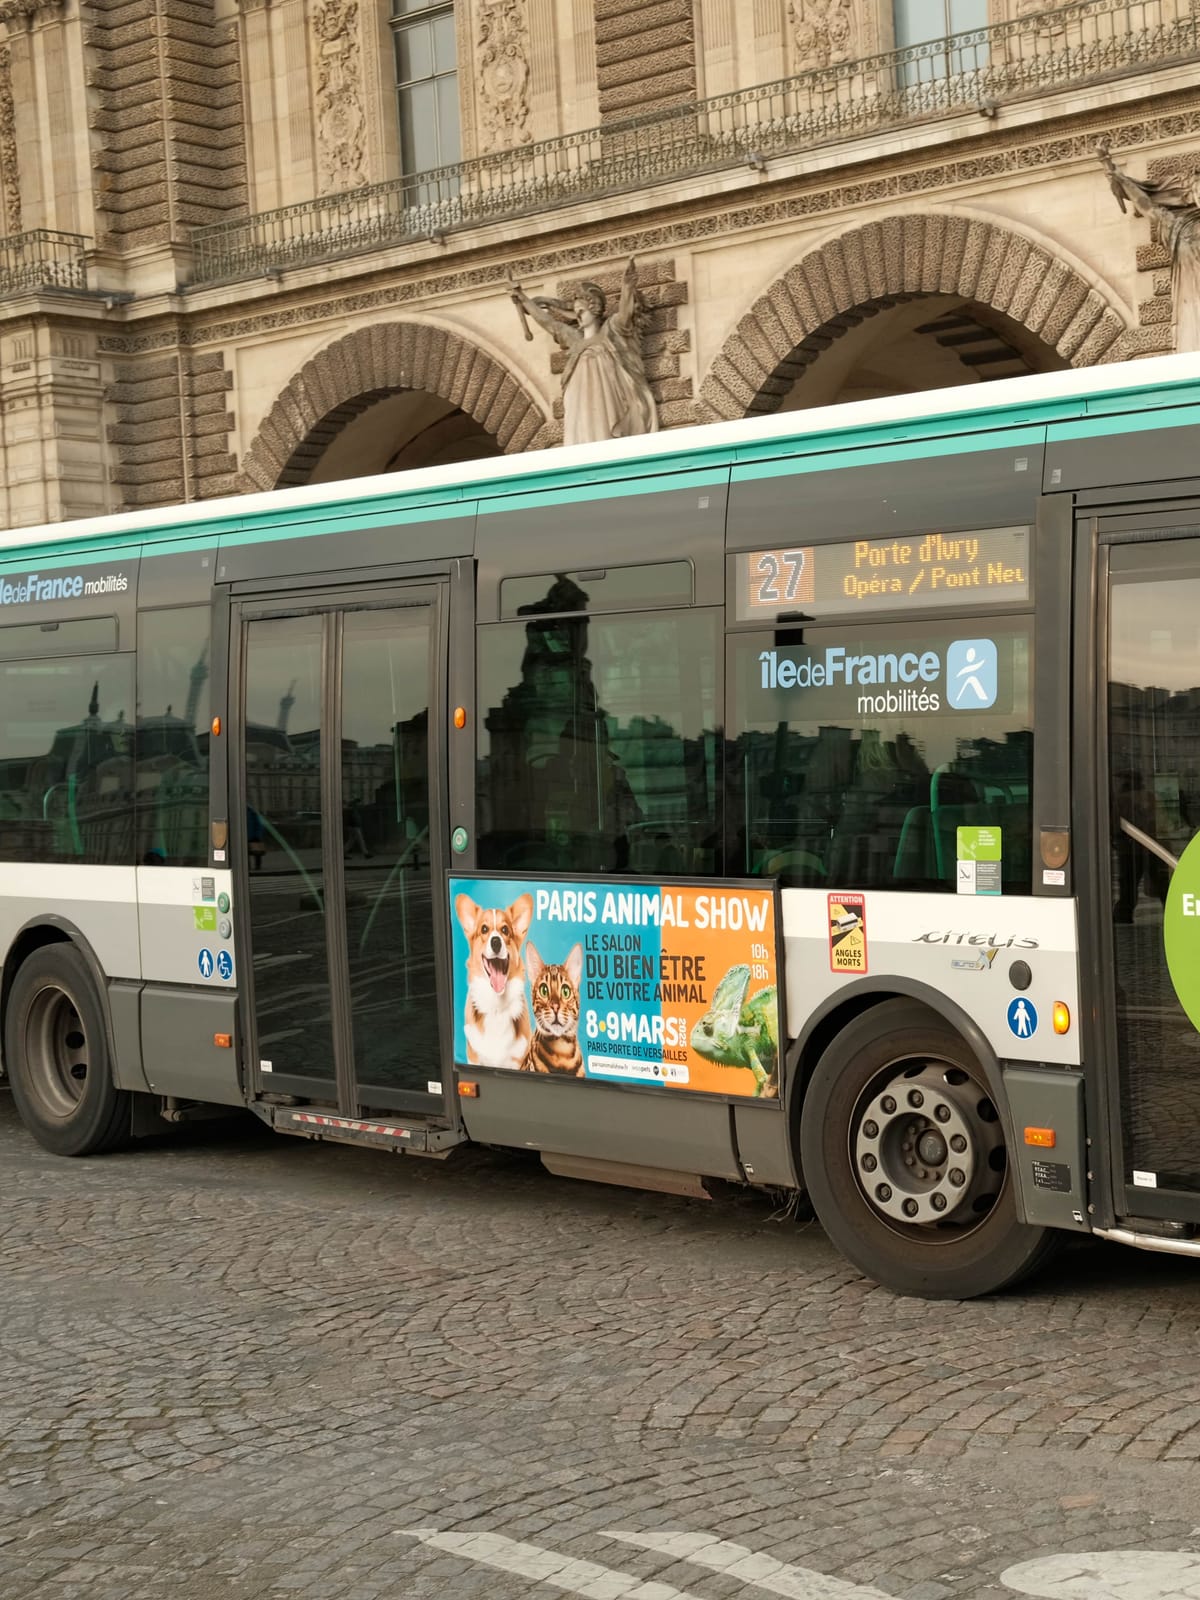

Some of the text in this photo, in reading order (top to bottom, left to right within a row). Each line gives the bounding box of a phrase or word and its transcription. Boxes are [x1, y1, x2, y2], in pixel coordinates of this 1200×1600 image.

[855, 541, 912, 568] Porte
[0, 573, 128, 605] ledeFrance mobilités
[758, 551, 805, 602] 27
[843, 573, 902, 599] Opéra
[931, 566, 981, 588] Pont
[857, 686, 941, 714] mobilités
[536, 889, 769, 932] PARIS ANIMAL SHOW
[829, 895, 863, 904] ATTENTION
[585, 934, 641, 952] LE SALON
[751, 943, 769, 960] 10h
[835, 948, 862, 958] ANGLES
[586, 948, 706, 981] DU BIEN ÊTRE
[752, 963, 769, 980] 18h
[836, 958, 862, 967] MORTS
[587, 982, 707, 1004] DE VOTRE ANIMAL
[620, 1012, 678, 1047] MARS
[678, 1018, 687, 1048] 2025
[587, 1041, 688, 1061] PARIS PORTE DE VERSAILLES
